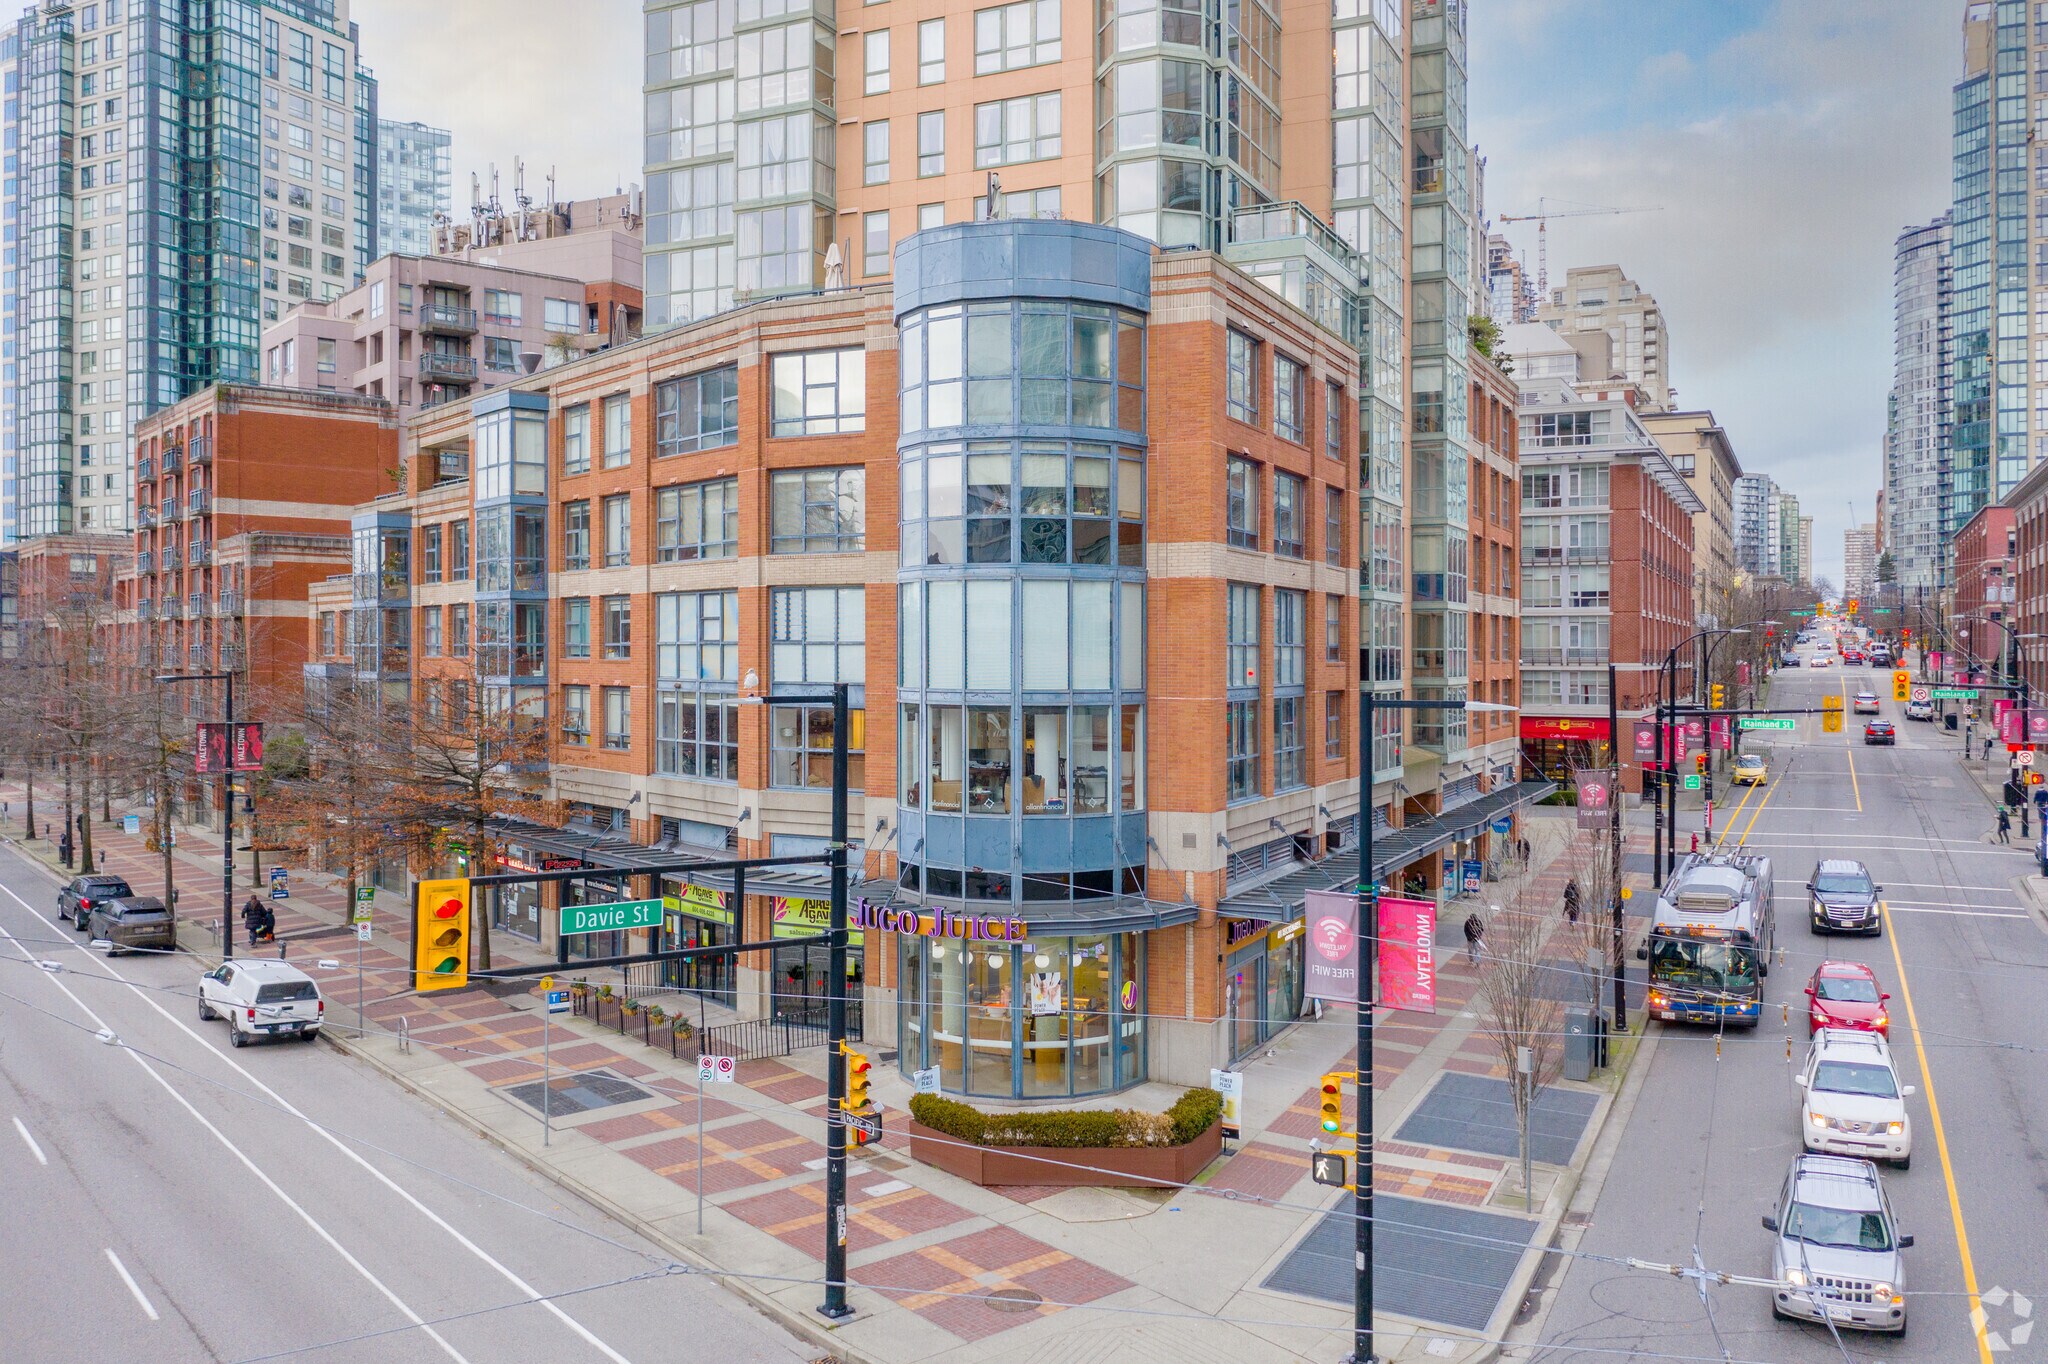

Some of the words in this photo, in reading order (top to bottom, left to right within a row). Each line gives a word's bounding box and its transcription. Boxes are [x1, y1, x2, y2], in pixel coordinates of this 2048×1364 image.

[1744, 720, 1780, 728] Mainland
[1782, 721, 1791, 729] St
[199, 728, 208, 762] YALETOWN
[237, 727, 246, 761] YALETOWN
[1025, 801, 1065, 810] allanfinancial
[545, 859, 582, 869] Pizza
[575, 907, 625, 929] Davie
[633, 905, 649, 923] St
[855, 896, 919, 935] JUGO
[926, 906, 1025, 941] JUICE
[1232, 920, 1252, 945] JUGO
[921, 1079, 933, 1087] PEACH
[1219, 1076, 1233, 1084] POWER
[846, 1113, 864, 1128] PACIFIC
